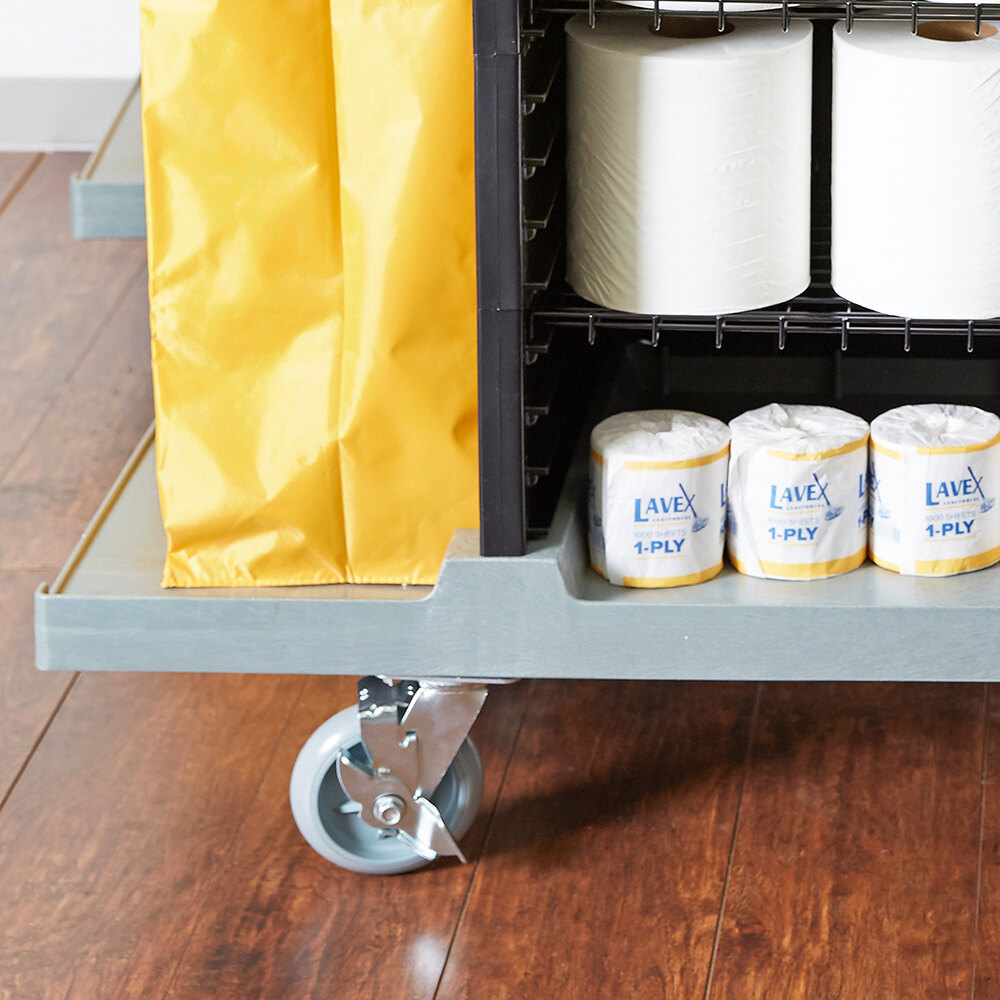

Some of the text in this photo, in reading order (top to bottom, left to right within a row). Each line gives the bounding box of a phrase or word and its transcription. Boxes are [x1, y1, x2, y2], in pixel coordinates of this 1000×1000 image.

[770, 475, 829, 509] LAVEX
[926, 468, 984, 506] LAVEX
[634, 486, 696, 522] LAVEX
[768, 526, 818, 541] 1-PLY
[926, 519, 975, 537] 1-PLY
[634, 539, 685, 554] 1-PLY
